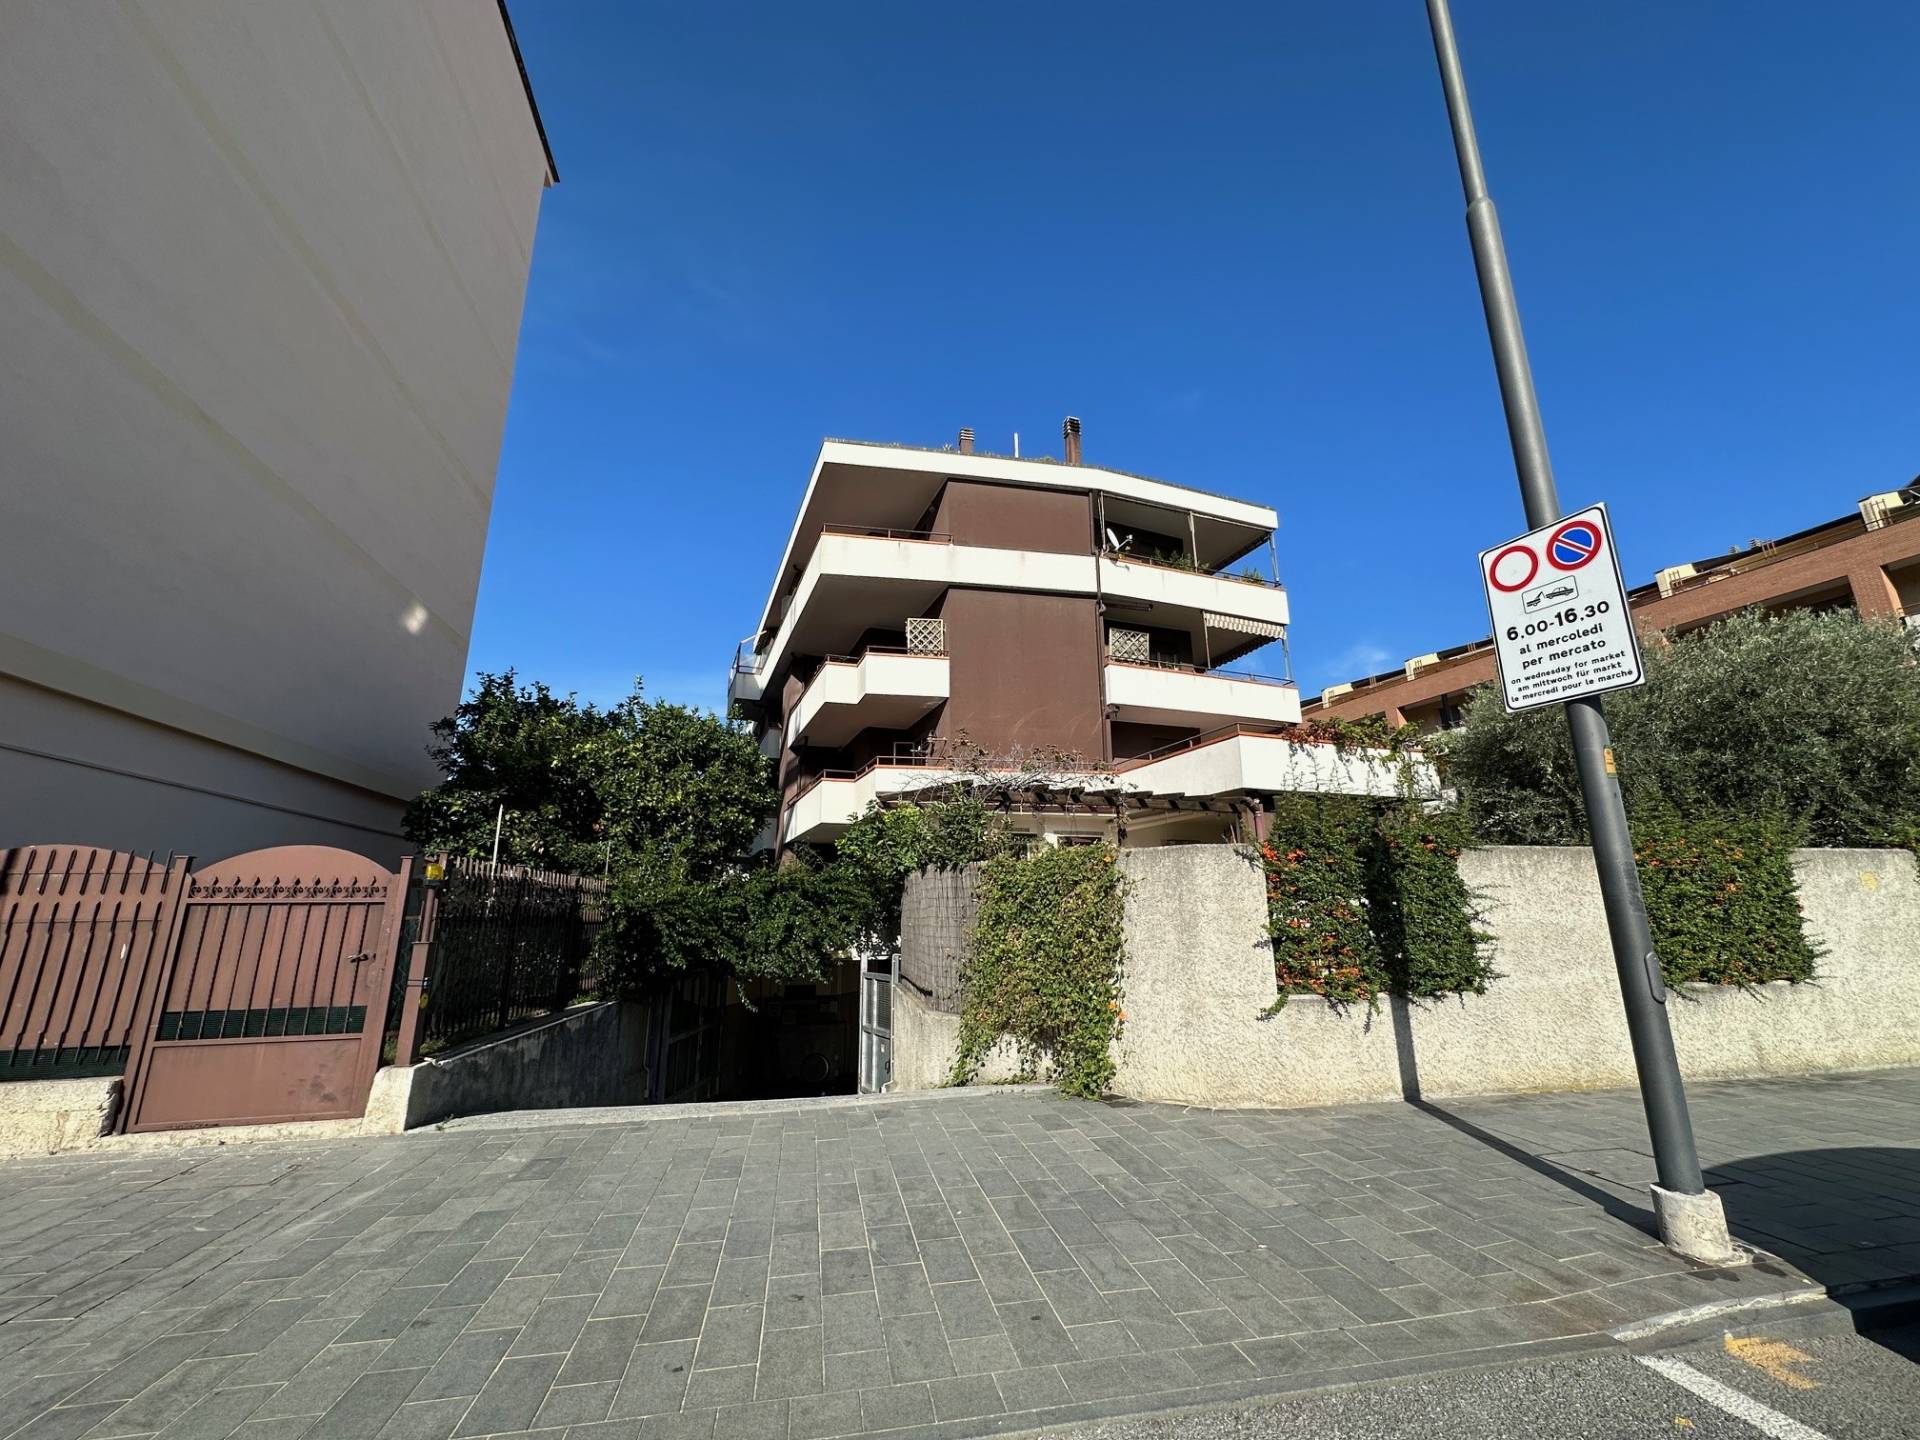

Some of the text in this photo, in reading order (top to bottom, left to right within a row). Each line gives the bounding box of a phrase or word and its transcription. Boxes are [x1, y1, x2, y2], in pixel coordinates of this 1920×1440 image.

[1507, 601, 1609, 640] 6.00-16.30
[1520, 644, 1531, 655] al
[1522, 639, 1606, 670] per mercato
[1524, 665, 1571, 681] wednesday
[1592, 650, 1626, 665] market
[1533, 675, 1573, 689] mittwoch
[1576, 669, 1589, 677] für
[1594, 661, 1622, 674] markt
[1523, 687, 1558, 700] mercredi
[1562, 682, 1582, 692] pour
